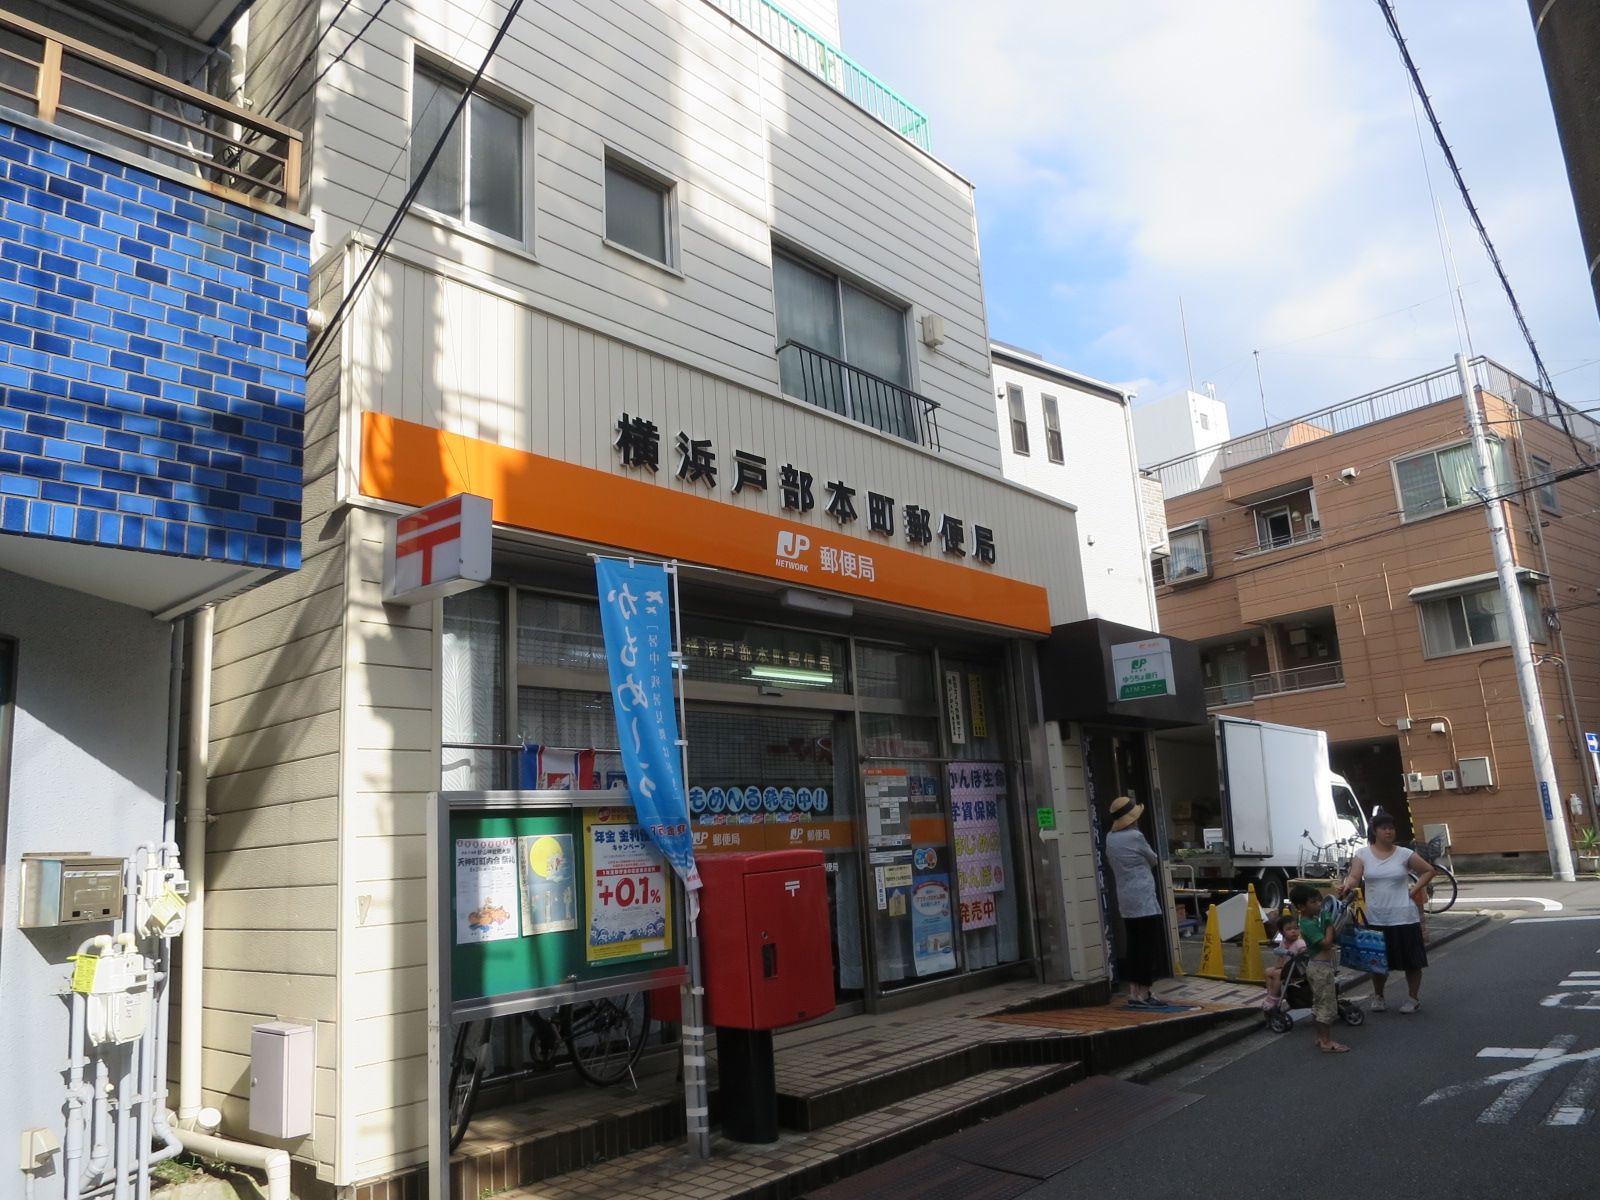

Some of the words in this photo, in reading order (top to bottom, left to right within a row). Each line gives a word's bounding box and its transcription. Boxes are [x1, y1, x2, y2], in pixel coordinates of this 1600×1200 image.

[616, 412, 996, 564] 横浜戸部本町郵便局
[775, 559, 809, 573] NETWORK
[819, 546, 875, 582] 郵便局
[594, 830, 615, 843] 年金
[713, 833, 740, 846] 郵便局
[807, 829, 830, 841] 郵便局
[960, 898, 995, 923] 発売中
